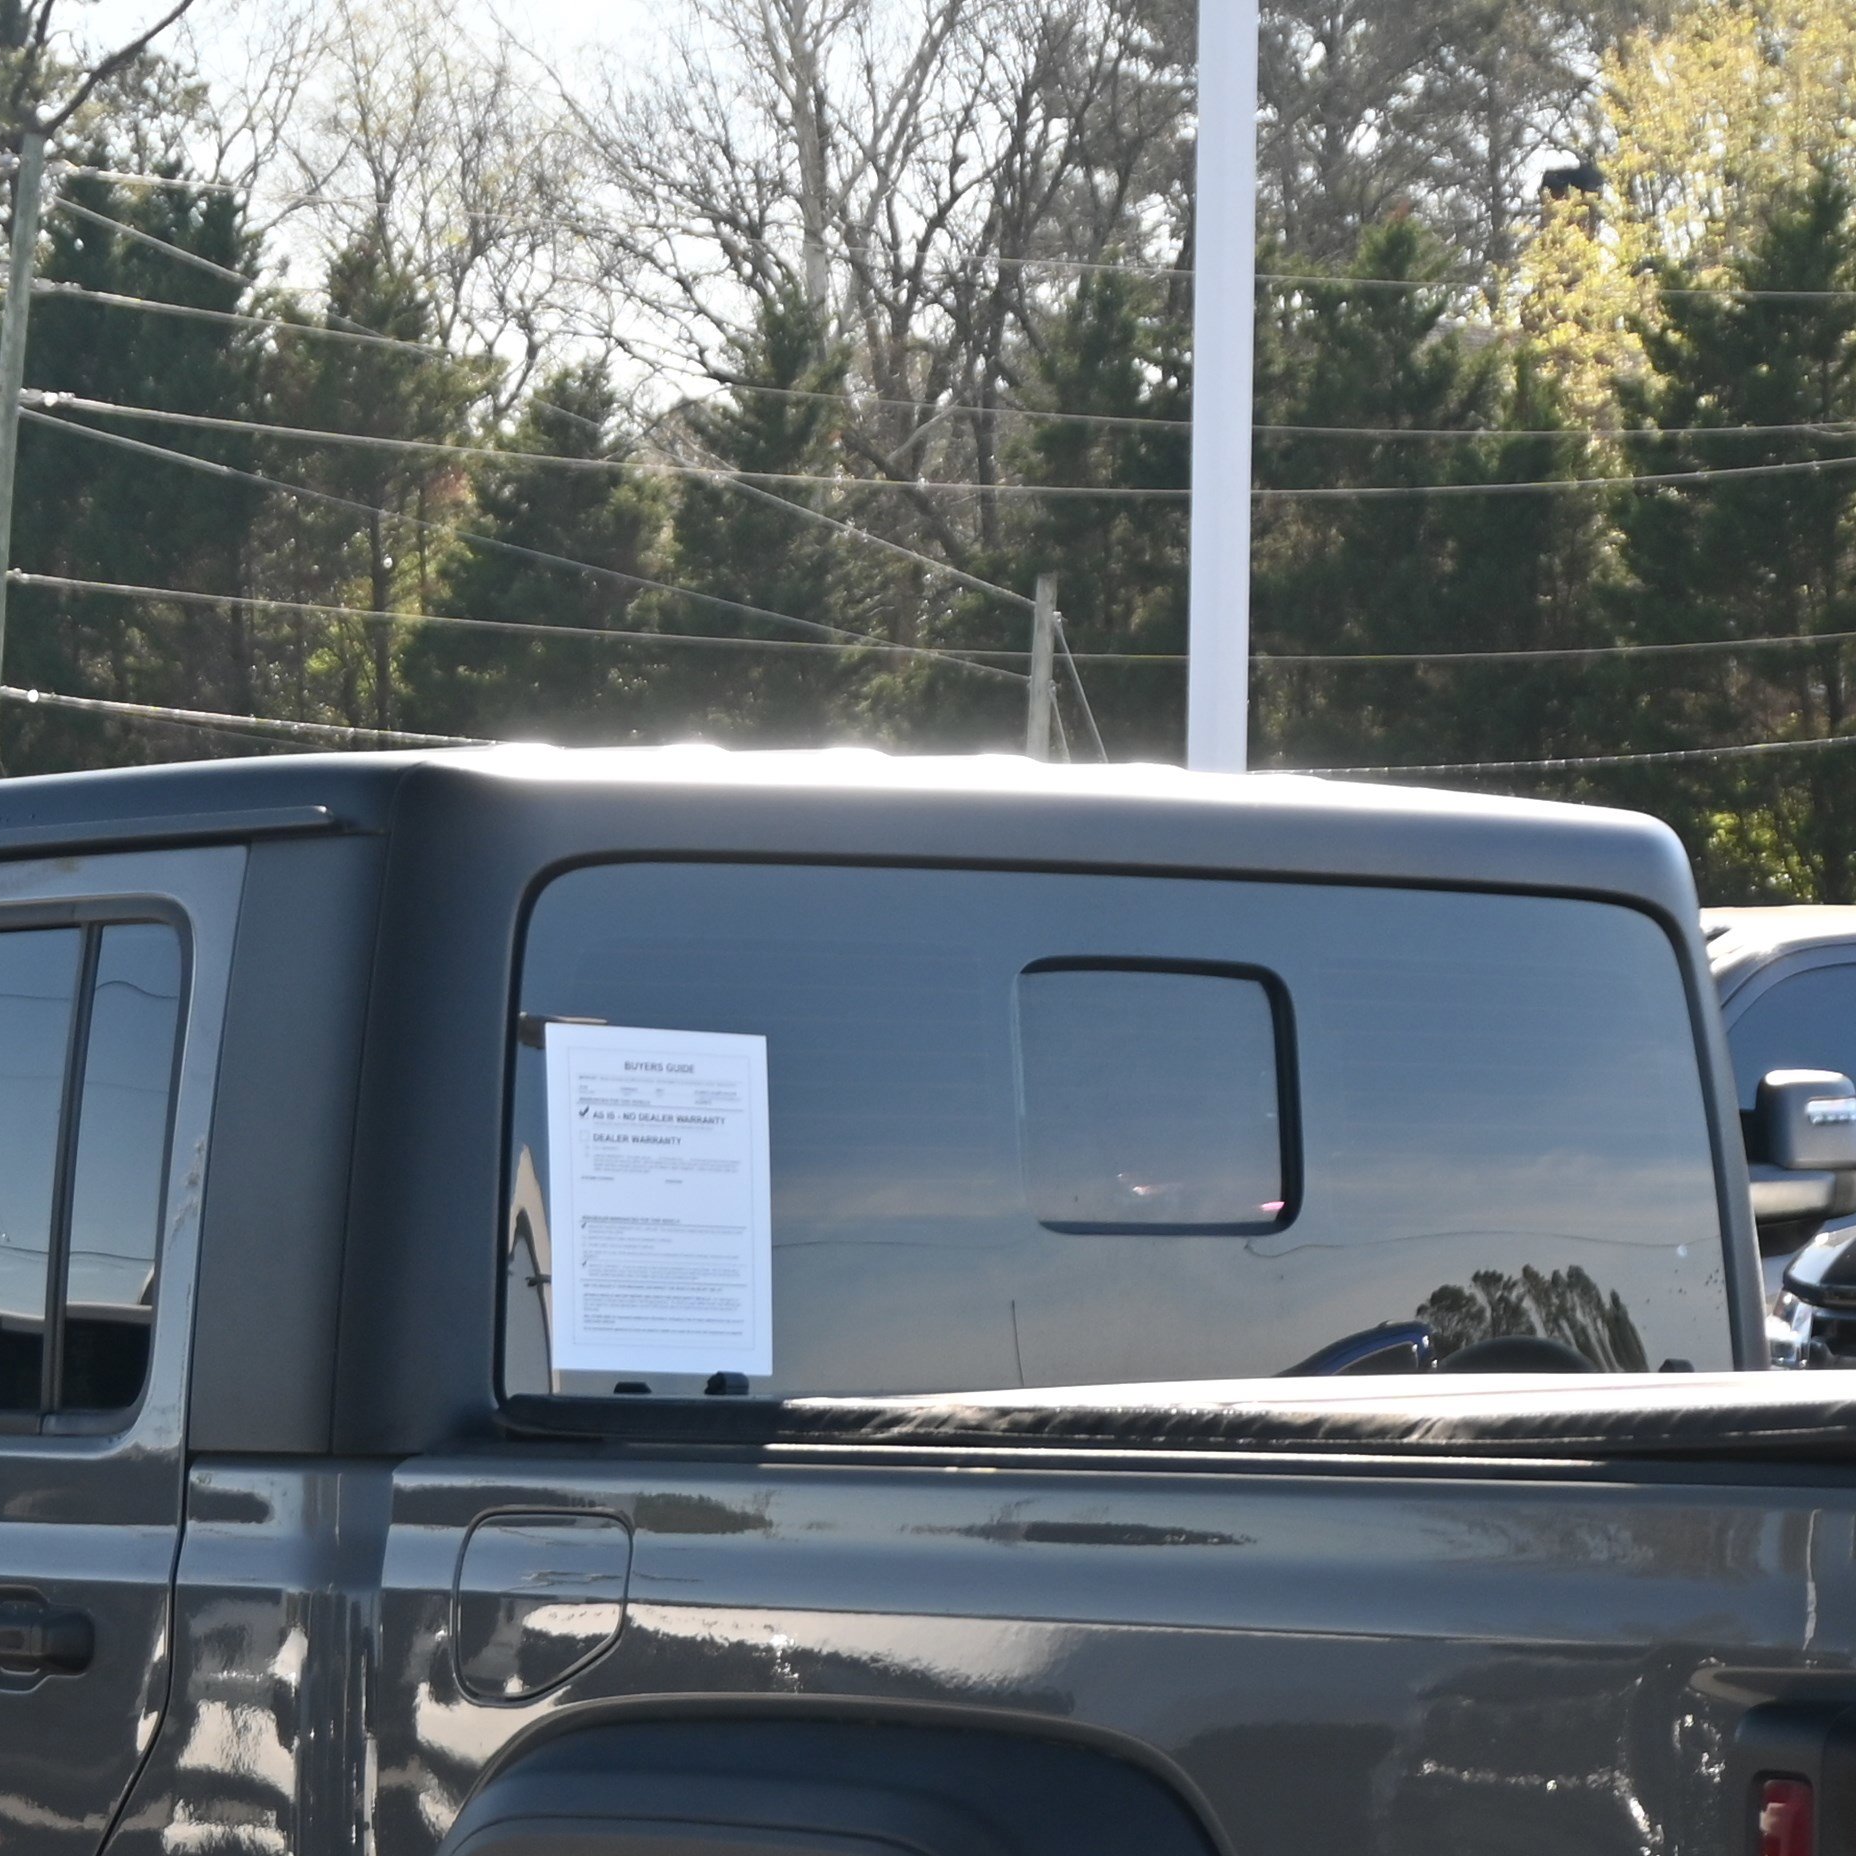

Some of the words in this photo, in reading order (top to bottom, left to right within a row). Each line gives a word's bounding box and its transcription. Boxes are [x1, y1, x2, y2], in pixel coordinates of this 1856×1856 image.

[624, 1061, 664, 1072] BUYERS
[666, 1063, 695, 1074] GUIDE
[593, 1111, 603, 1120] AS
[606, 1111, 616, 1120] IS
[623, 1111, 636, 1121] NO
[638, 1112, 674, 1123] DEALER
[676, 1114, 726, 1125] WARRANTY
[593, 1132, 630, 1143] DEALER
[632, 1134, 682, 1146] WARRANTY
